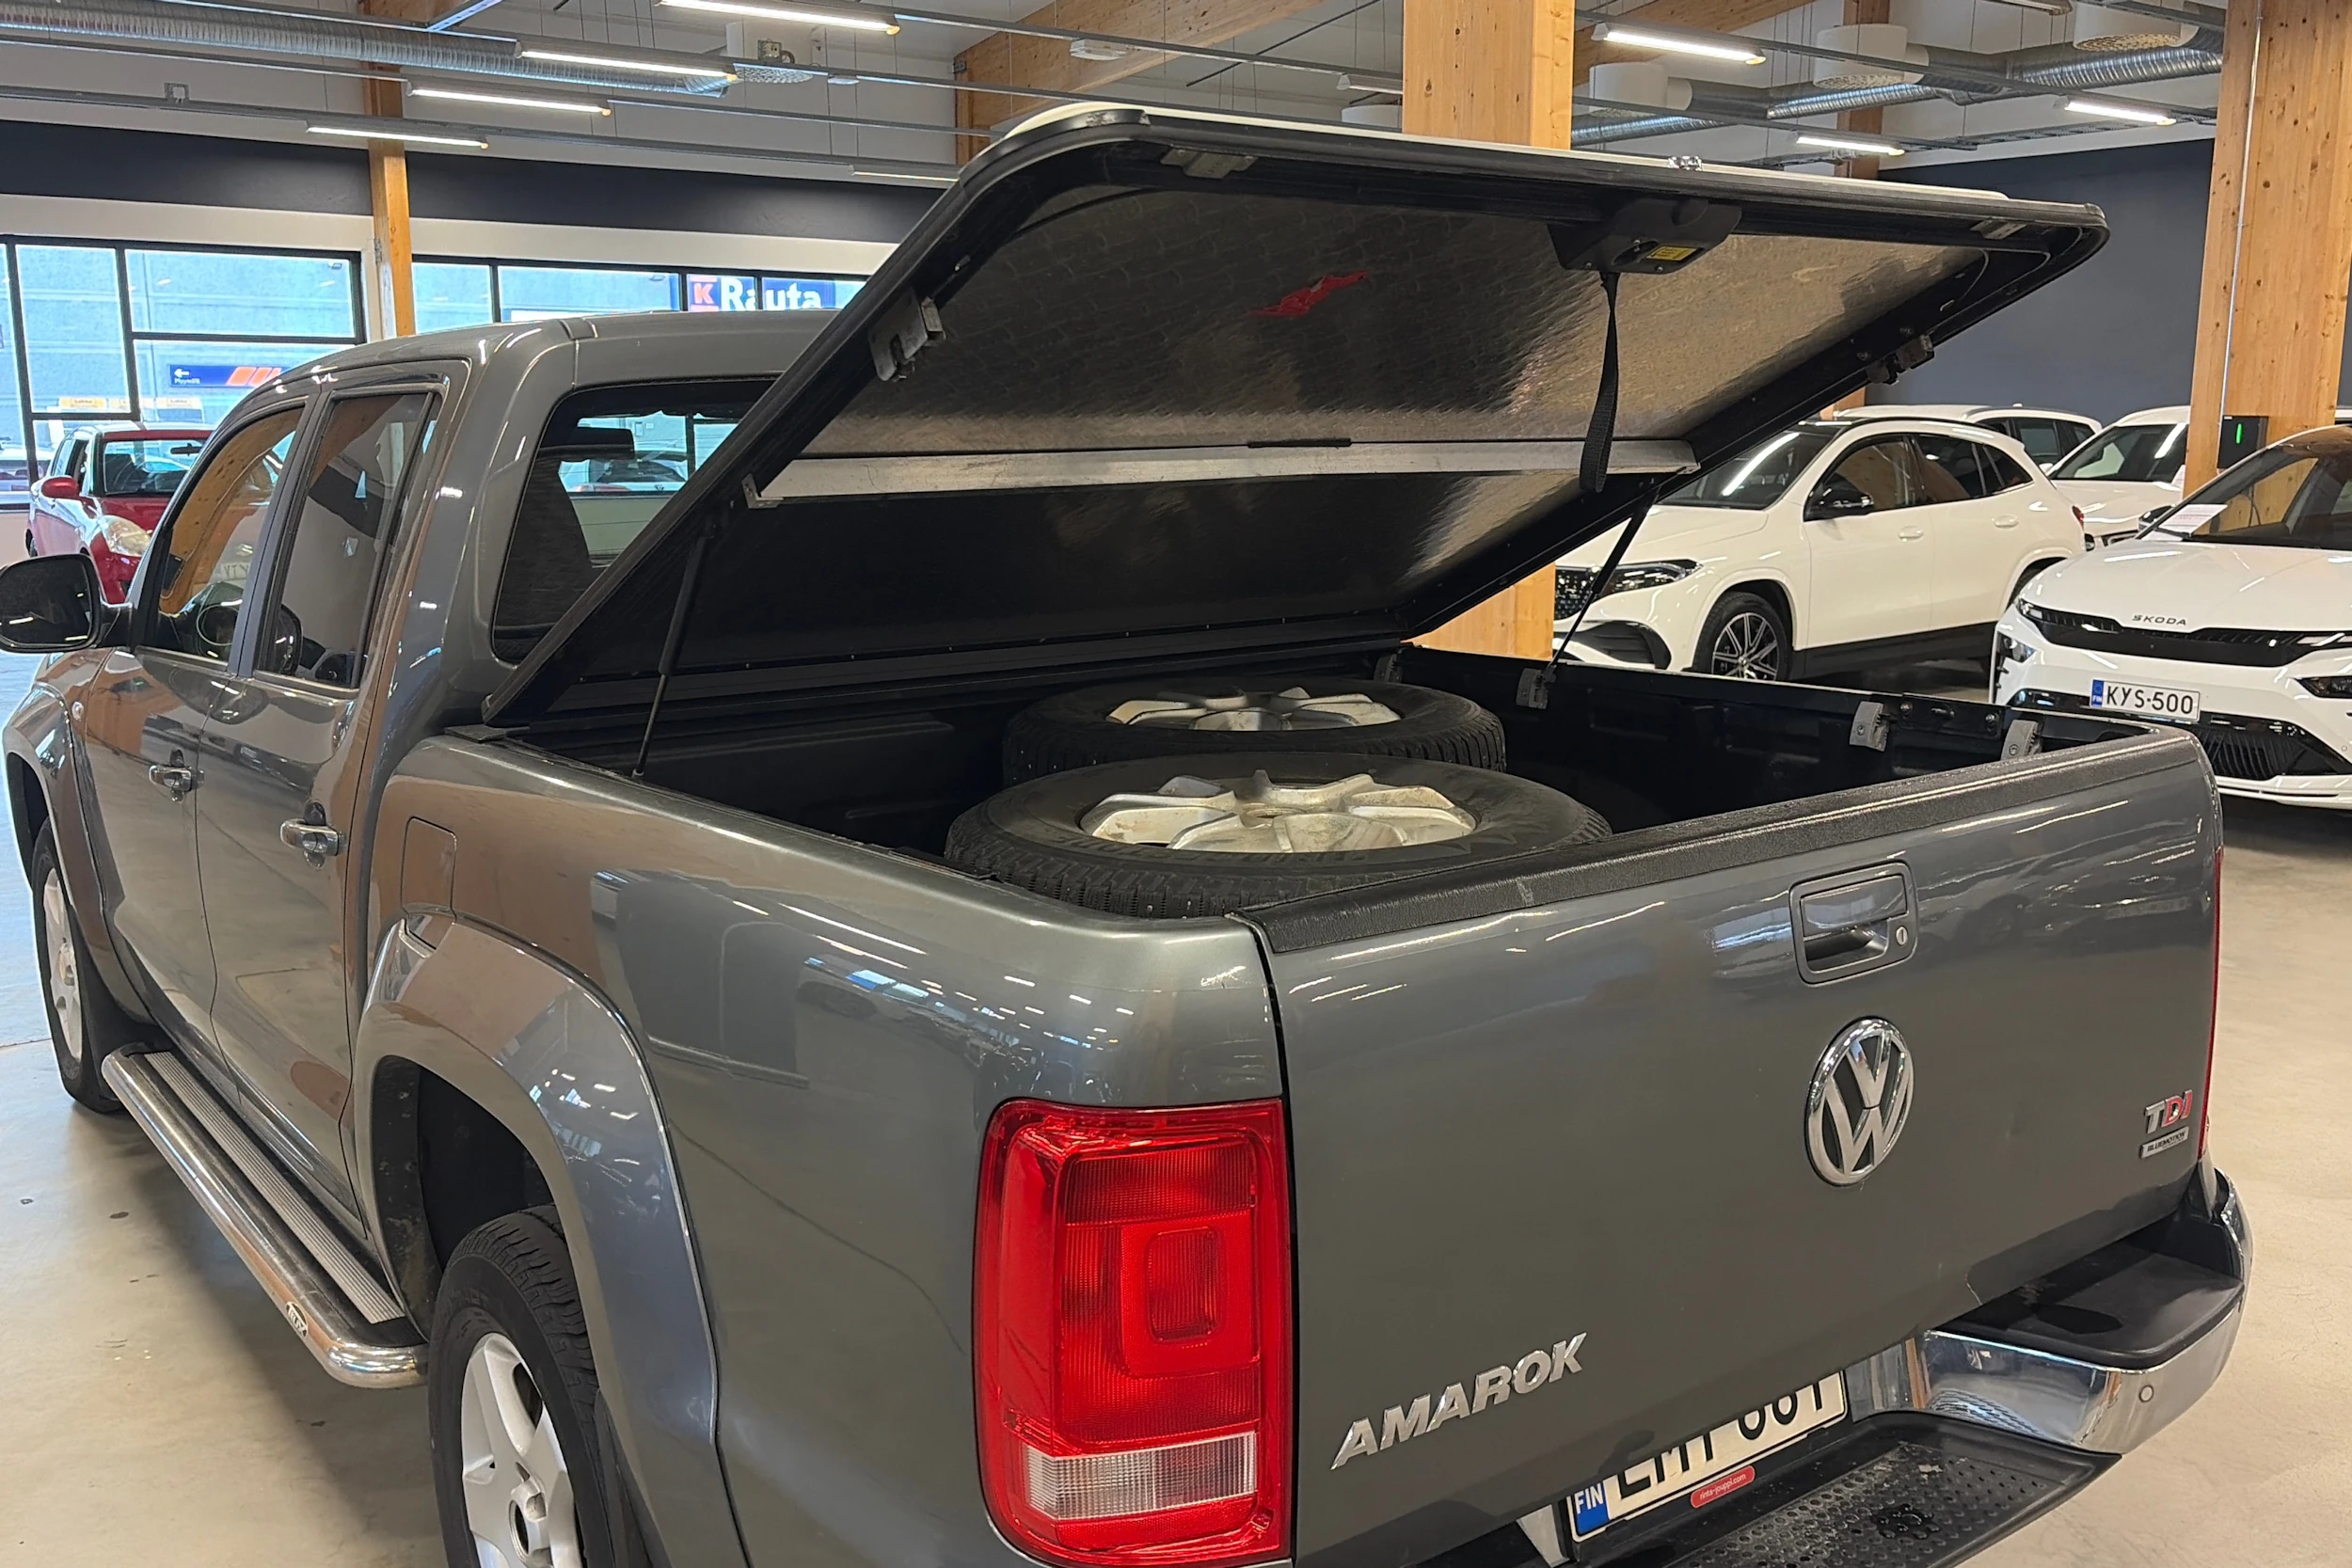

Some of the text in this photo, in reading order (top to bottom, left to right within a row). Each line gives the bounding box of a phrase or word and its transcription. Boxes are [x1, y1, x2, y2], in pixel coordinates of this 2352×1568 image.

[693, 277, 822, 311] K Rauta
[2092, 694, 2104, 704] FIN
[2106, 685, 2194, 715] KYS-500
[2144, 1088, 2193, 1134] TDI
[2147, 1131, 2186, 1152] BLUEMOTION
[1330, 1332, 1587, 1470] AMAROK
[1576, 1482, 1604, 1514] FIN
[1699, 1473, 1747, 1500] rinta-jouppi.com
